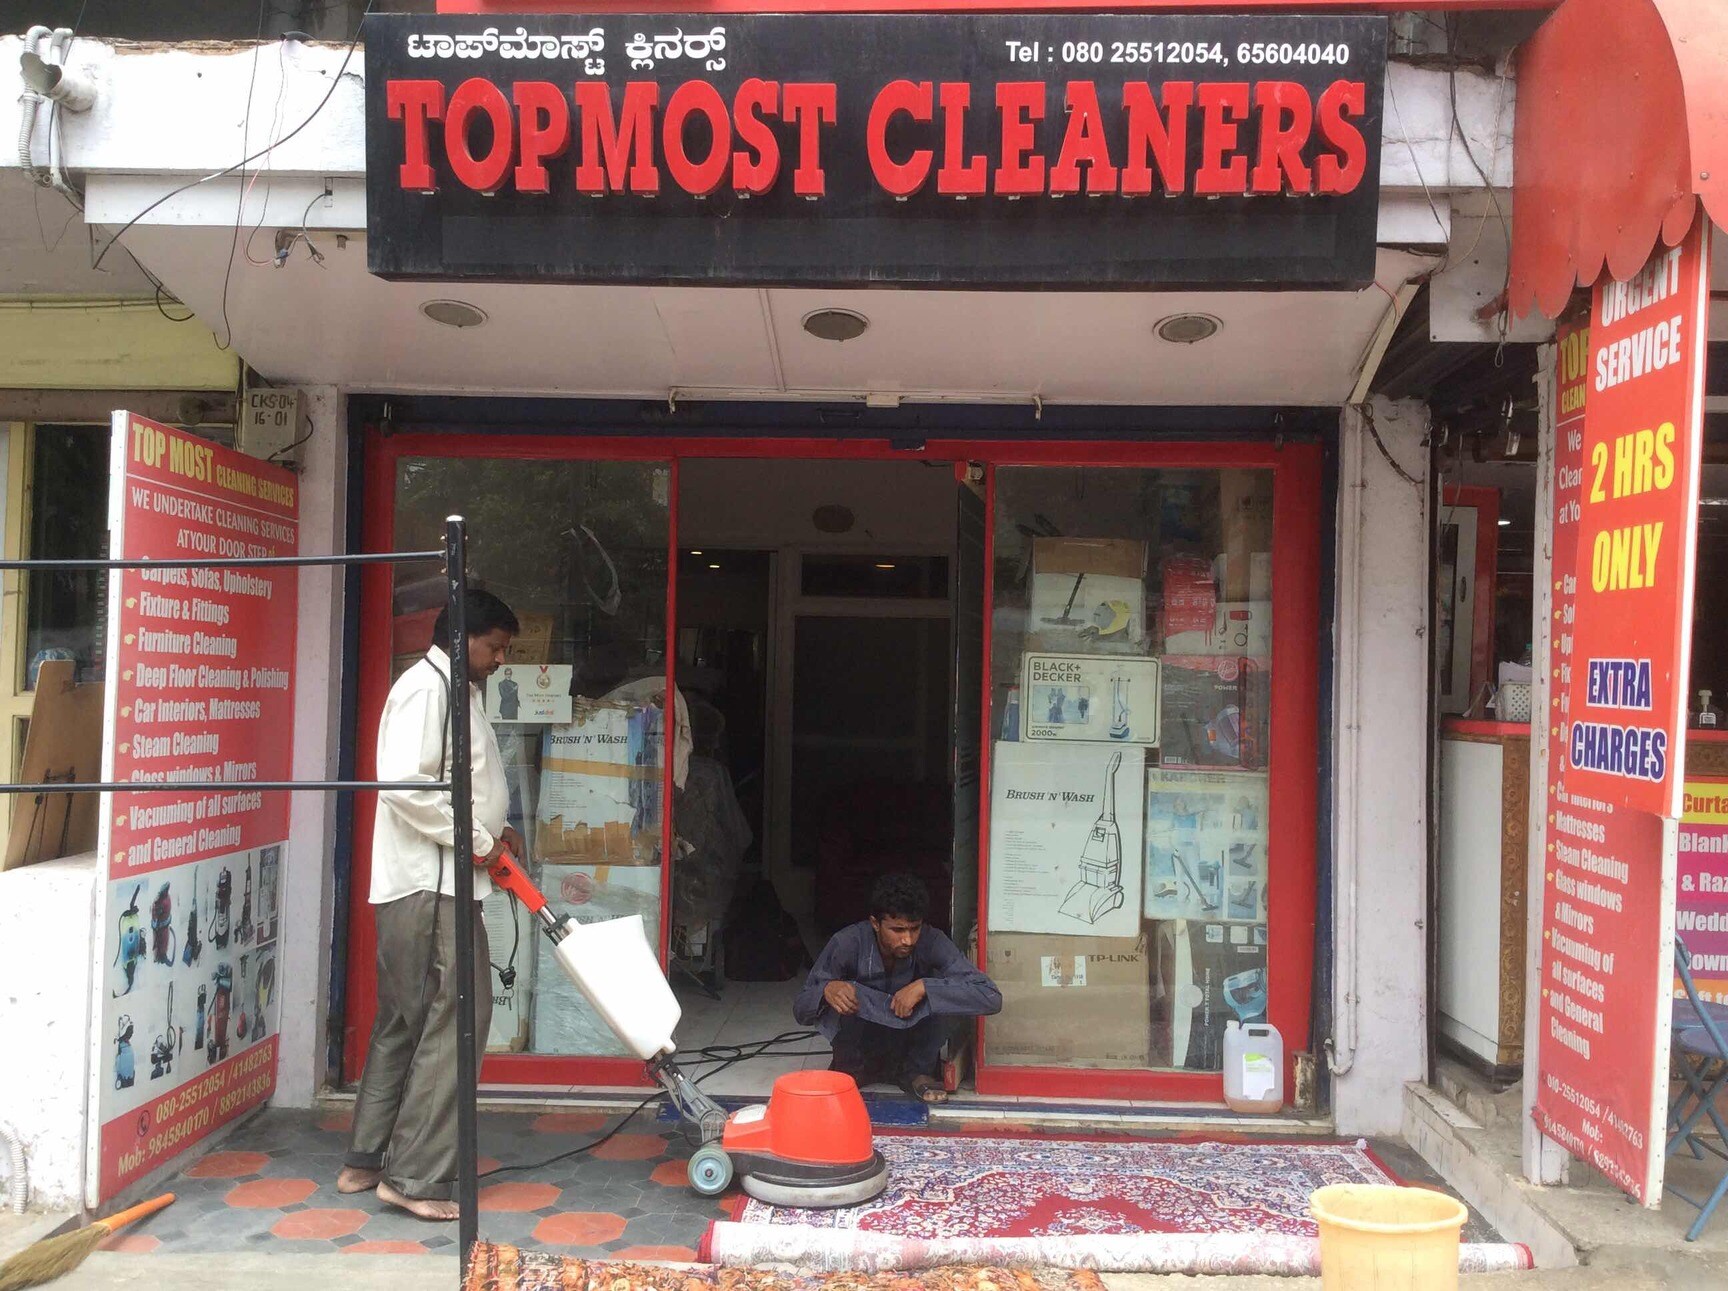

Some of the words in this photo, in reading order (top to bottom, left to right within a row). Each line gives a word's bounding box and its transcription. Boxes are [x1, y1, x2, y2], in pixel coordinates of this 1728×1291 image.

[1006, 42, 1039, 62] Tel
[1062, 42, 1103, 63] 080
[1110, 42, 1229, 66] 25512054,
[1237, 43, 1350, 65] 65604040
[386, 77, 837, 197] TOPMOST
[866, 79, 1367, 197] CLEANERS
[1601, 246, 1683, 327] URGENT
[1595, 314, 1683, 393] SERVICE
[1567, 429, 1582, 453] We
[133, 422, 166, 468] TOP
[169, 435, 214, 483] MOST
[216, 464, 257, 496] CLEANING
[257, 478, 294, 508] SERVICES
[1590, 440, 1609, 504] 2
[1612, 421, 1676, 500] HRS
[132, 486, 150, 510] WE
[153, 492, 213, 524] UNDERTAKE
[216, 508, 259, 535] CLEANING
[260, 520, 295, 544] SERVICES
[1559, 504, 1568, 524] at
[219, 538, 246, 558] DOOR
[1591, 521, 1664, 594] ONLY
[223, 570, 273, 600] Upholstery
[140, 591, 180, 617] Fixture
[182, 602, 190, 620] &
[191, 597, 230, 626] Fittings
[138, 626, 191, 654] Furniture
[192, 631, 238, 659] Cleaning
[136, 662, 167, 690] Deep
[169, 664, 197, 687] Floor
[198, 664, 242, 690] Cleaning
[242, 672, 249, 687] &
[250, 666, 289, 690] Polishing
[1033, 661, 1081, 672] BLACK+
[1033, 672, 1082, 682] DECKER
[1586, 657, 1653, 711] EXTRA
[134, 698, 157, 723] Car
[157, 698, 208, 722] Interiors,
[208, 698, 261, 721] Mattresses
[133, 733, 171, 760] Steam
[172, 731, 219, 755] Cleaning
[1569, 719, 1668, 784] CHARGES
[223, 760, 257, 782] Mirrors
[129, 800, 194, 831] Vacuuming
[196, 796, 207, 819] of
[207, 794, 221, 818] all
[222, 791, 262, 815] surfaces
[1555, 810, 1606, 843] Mattresses
[128, 838, 152, 867] and
[153, 830, 197, 862] General
[199, 824, 242, 851] Cleaning
[1556, 839, 1580, 868] Steam
[1581, 848, 1629, 885] Cleaning
[1555, 868, 1576, 896] Glass
[1576, 879, 1623, 913] windows
[1681, 873, 1695, 892] &
[1561, 902, 1594, 935] Mirrors
[1088, 954, 1139, 962] TP-LINK
[1551, 926, 1601, 972] Vacuuming
[1602, 952, 1615, 976] of
[1552, 960, 1562, 982] all
[1562, 966, 1605, 1003] surfaces
[1550, 989, 1564, 1013] and
[1564, 995, 1604, 1034] General
[1551, 1015, 1590, 1061] Cleaning
[118, 1146, 146, 1178] Mob:
